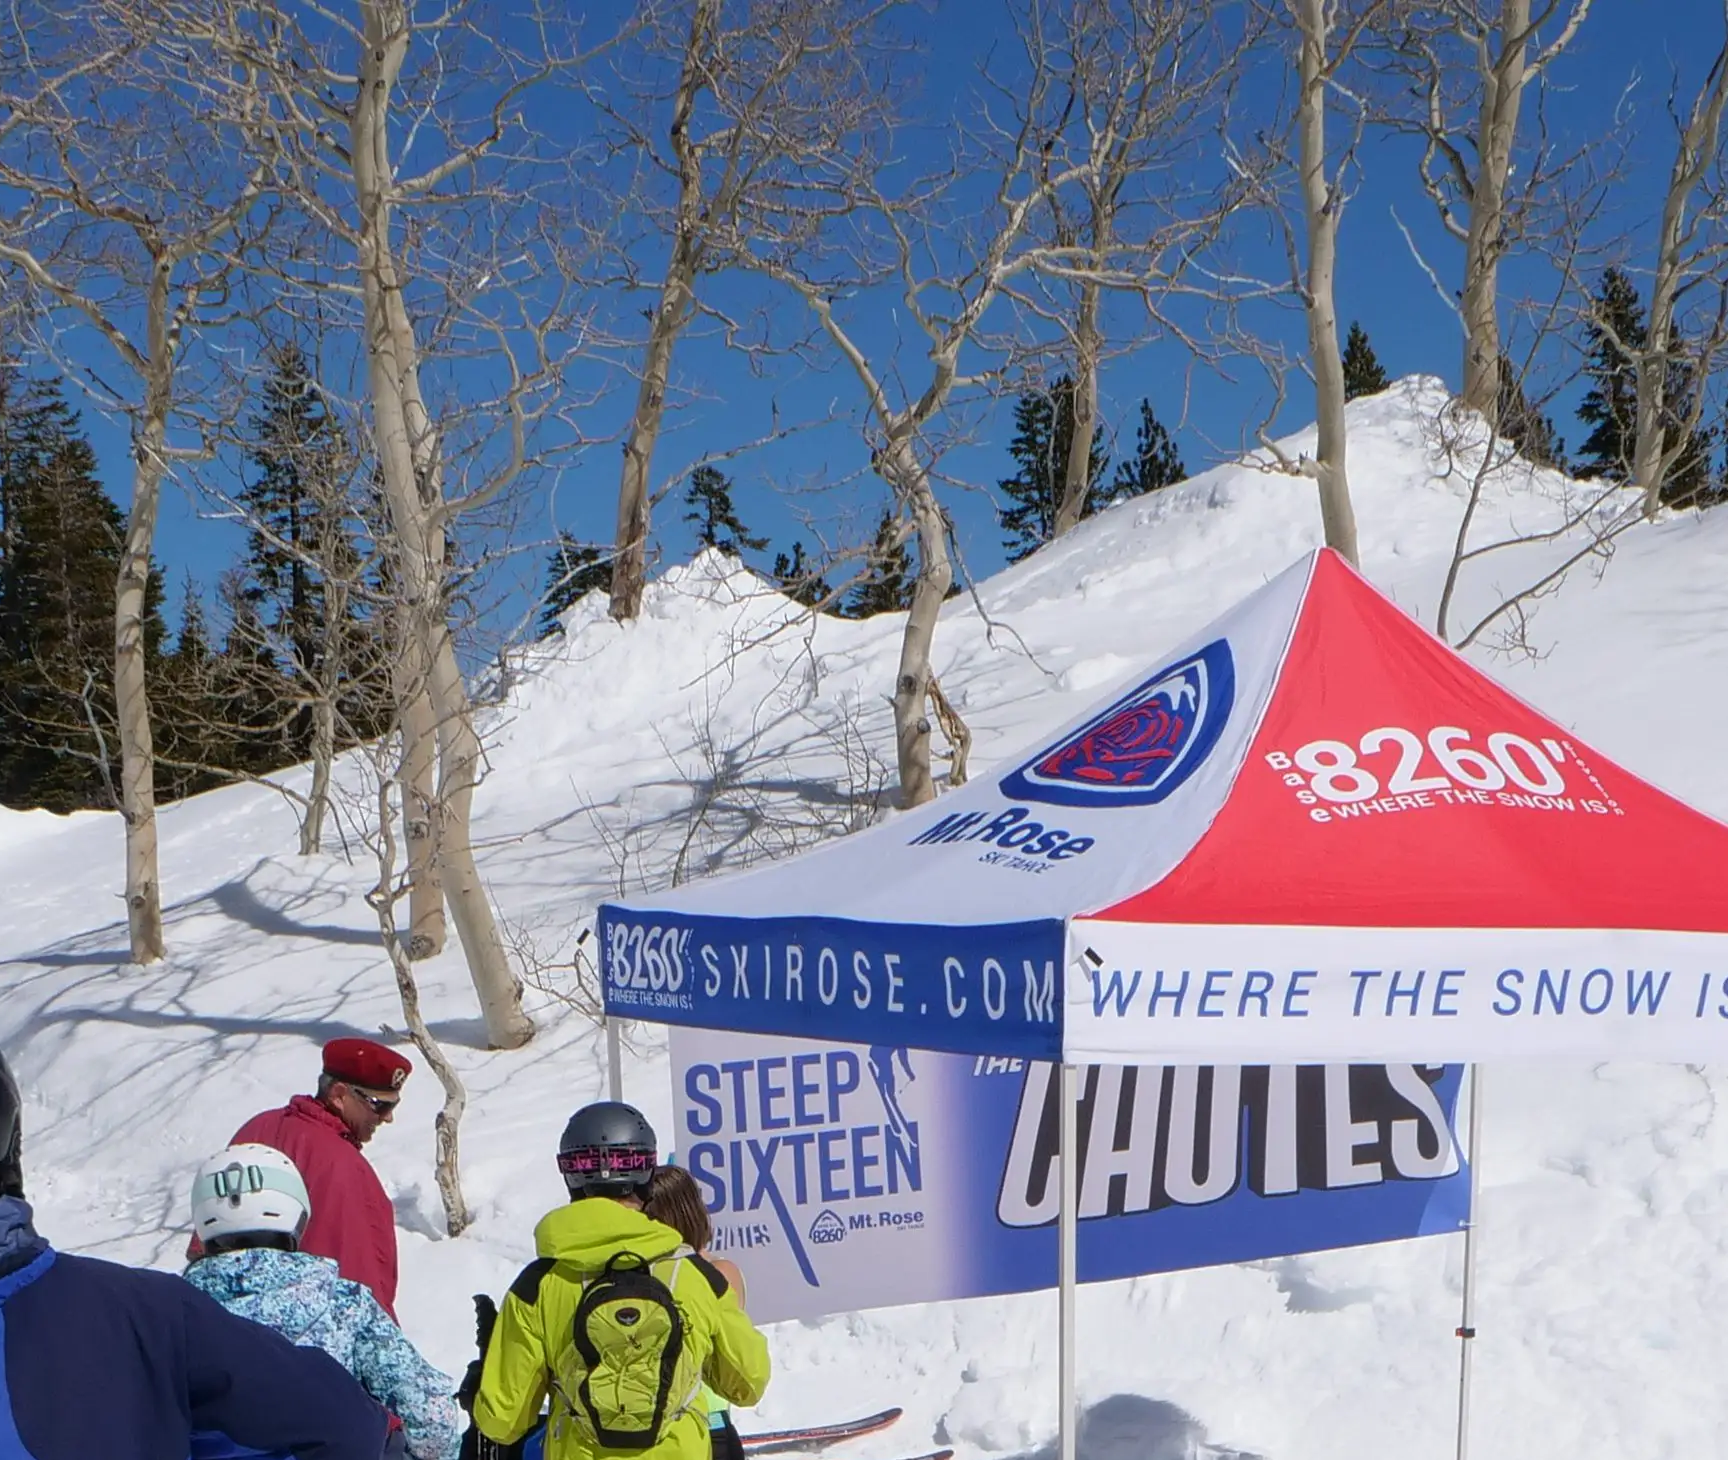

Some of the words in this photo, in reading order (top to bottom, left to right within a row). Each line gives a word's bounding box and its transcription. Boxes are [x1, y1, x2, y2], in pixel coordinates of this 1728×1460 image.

[1330, 791, 1435, 818] WHERE
[1436, 789, 1496, 806] THE
[1498, 792, 1576, 812] SNOW
[1579, 798, 1609, 814] IS
[965, 807, 1096, 860] Rose
[978, 851, 1008, 865] SKI
[614, 989, 638, 1005] WHERE
[639, 991, 655, 1007] THE
[700, 943, 1054, 1024] SKIROSE.COM
[1091, 969, 1318, 1018] WHERE
[1349, 970, 1466, 1018] THE
[1492, 968, 1672, 1016] SNOW
[684, 1050, 861, 1137] STEEP
[997, 1063, 1460, 1227] CHUTES
[687, 1120, 923, 1287] SIXTEEN
[848, 1213, 877, 1230] Mt.
[878, 1210, 924, 1227] Rose
